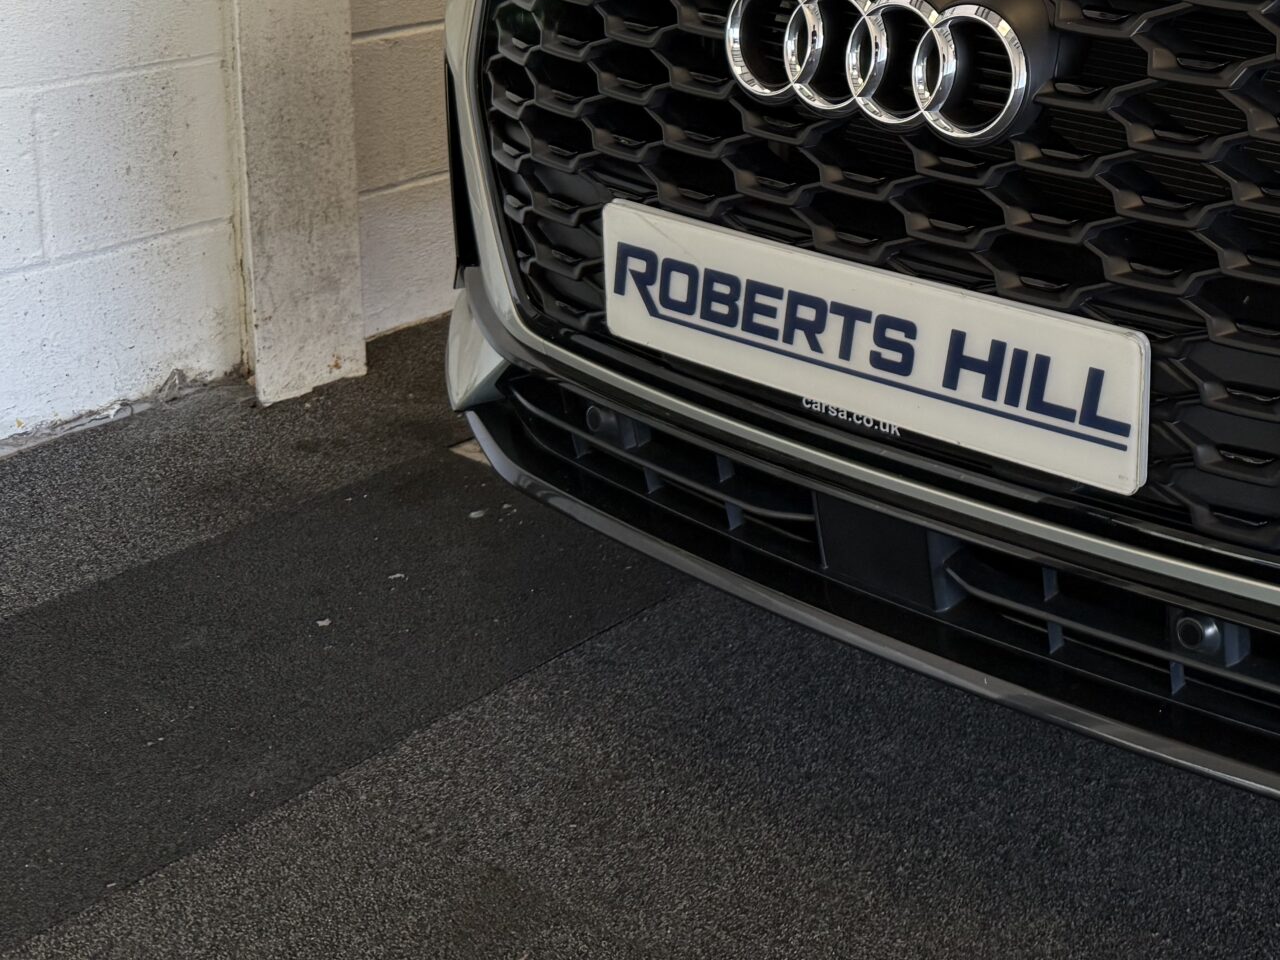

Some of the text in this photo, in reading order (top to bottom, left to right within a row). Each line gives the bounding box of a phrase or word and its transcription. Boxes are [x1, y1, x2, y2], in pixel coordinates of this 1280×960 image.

[613, 241, 1132, 438] ROBERTS HILL
[802, 396, 901, 437] carsa.co.uk
